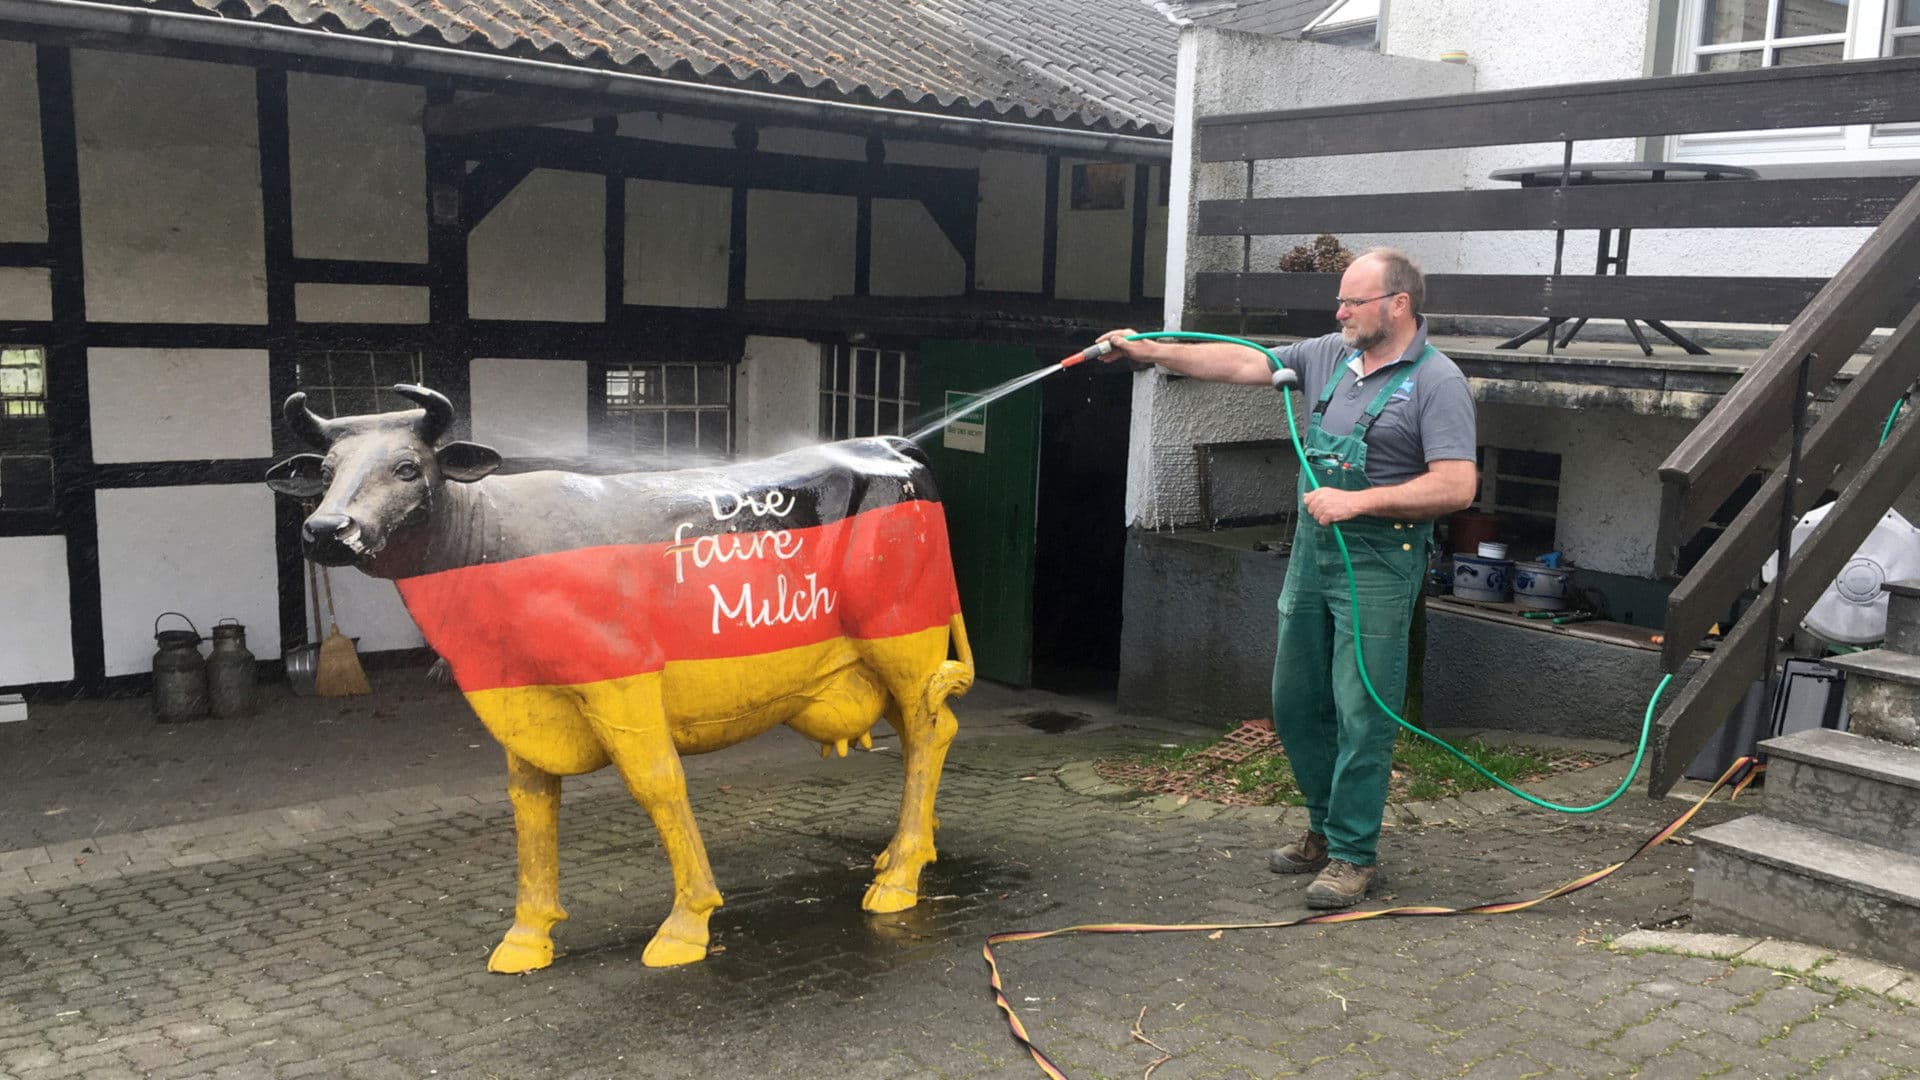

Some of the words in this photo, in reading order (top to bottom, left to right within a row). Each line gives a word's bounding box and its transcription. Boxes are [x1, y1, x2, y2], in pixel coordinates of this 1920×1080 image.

[708, 488, 796, 521] Die
[664, 523, 804, 583] faire
[709, 573, 837, 634] Milch
